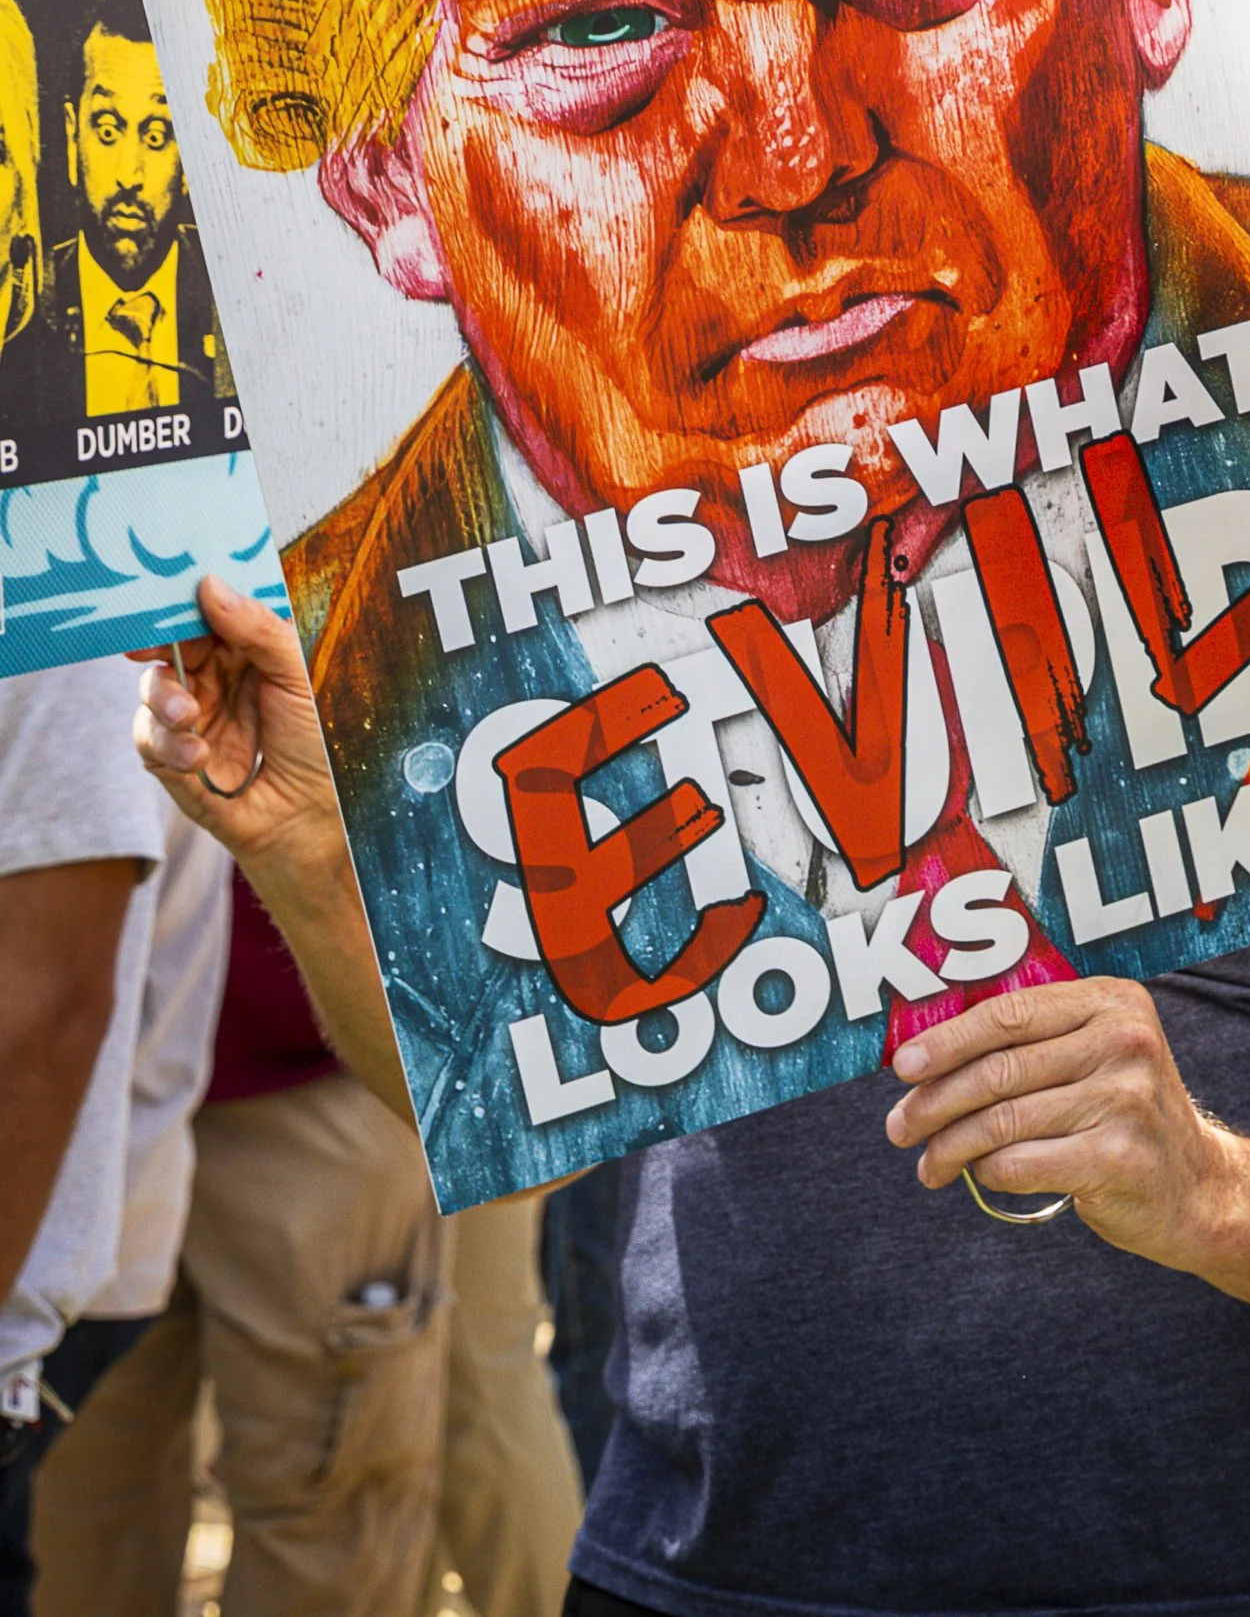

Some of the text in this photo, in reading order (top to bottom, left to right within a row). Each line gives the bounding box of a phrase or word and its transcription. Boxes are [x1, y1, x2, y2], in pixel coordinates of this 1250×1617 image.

[77, 413, 192, 462] DUMBER
[396, 487, 715, 654] THIS
[736, 442, 869, 559] IS
[509, 868, 1030, 1126] LOOKS
